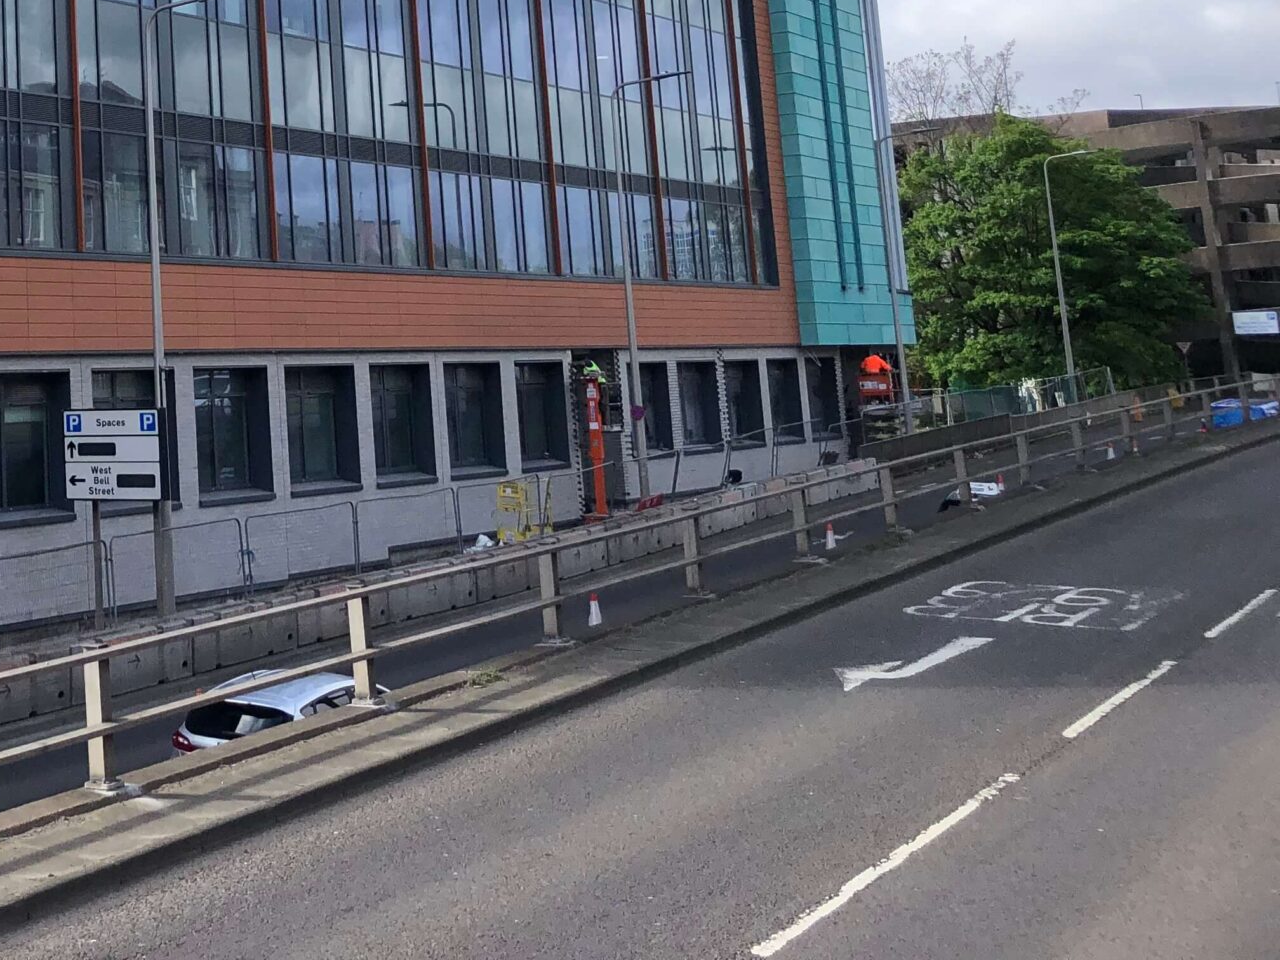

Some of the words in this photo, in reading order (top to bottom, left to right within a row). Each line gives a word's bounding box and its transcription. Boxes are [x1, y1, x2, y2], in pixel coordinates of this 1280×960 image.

[69, 415, 79, 431] P
[96, 419, 126, 428] Spaces
[143, 414, 153, 430] P
[90, 466, 112, 475] West
[93, 476, 110, 485] Bell
[88, 486, 115, 496] Street
